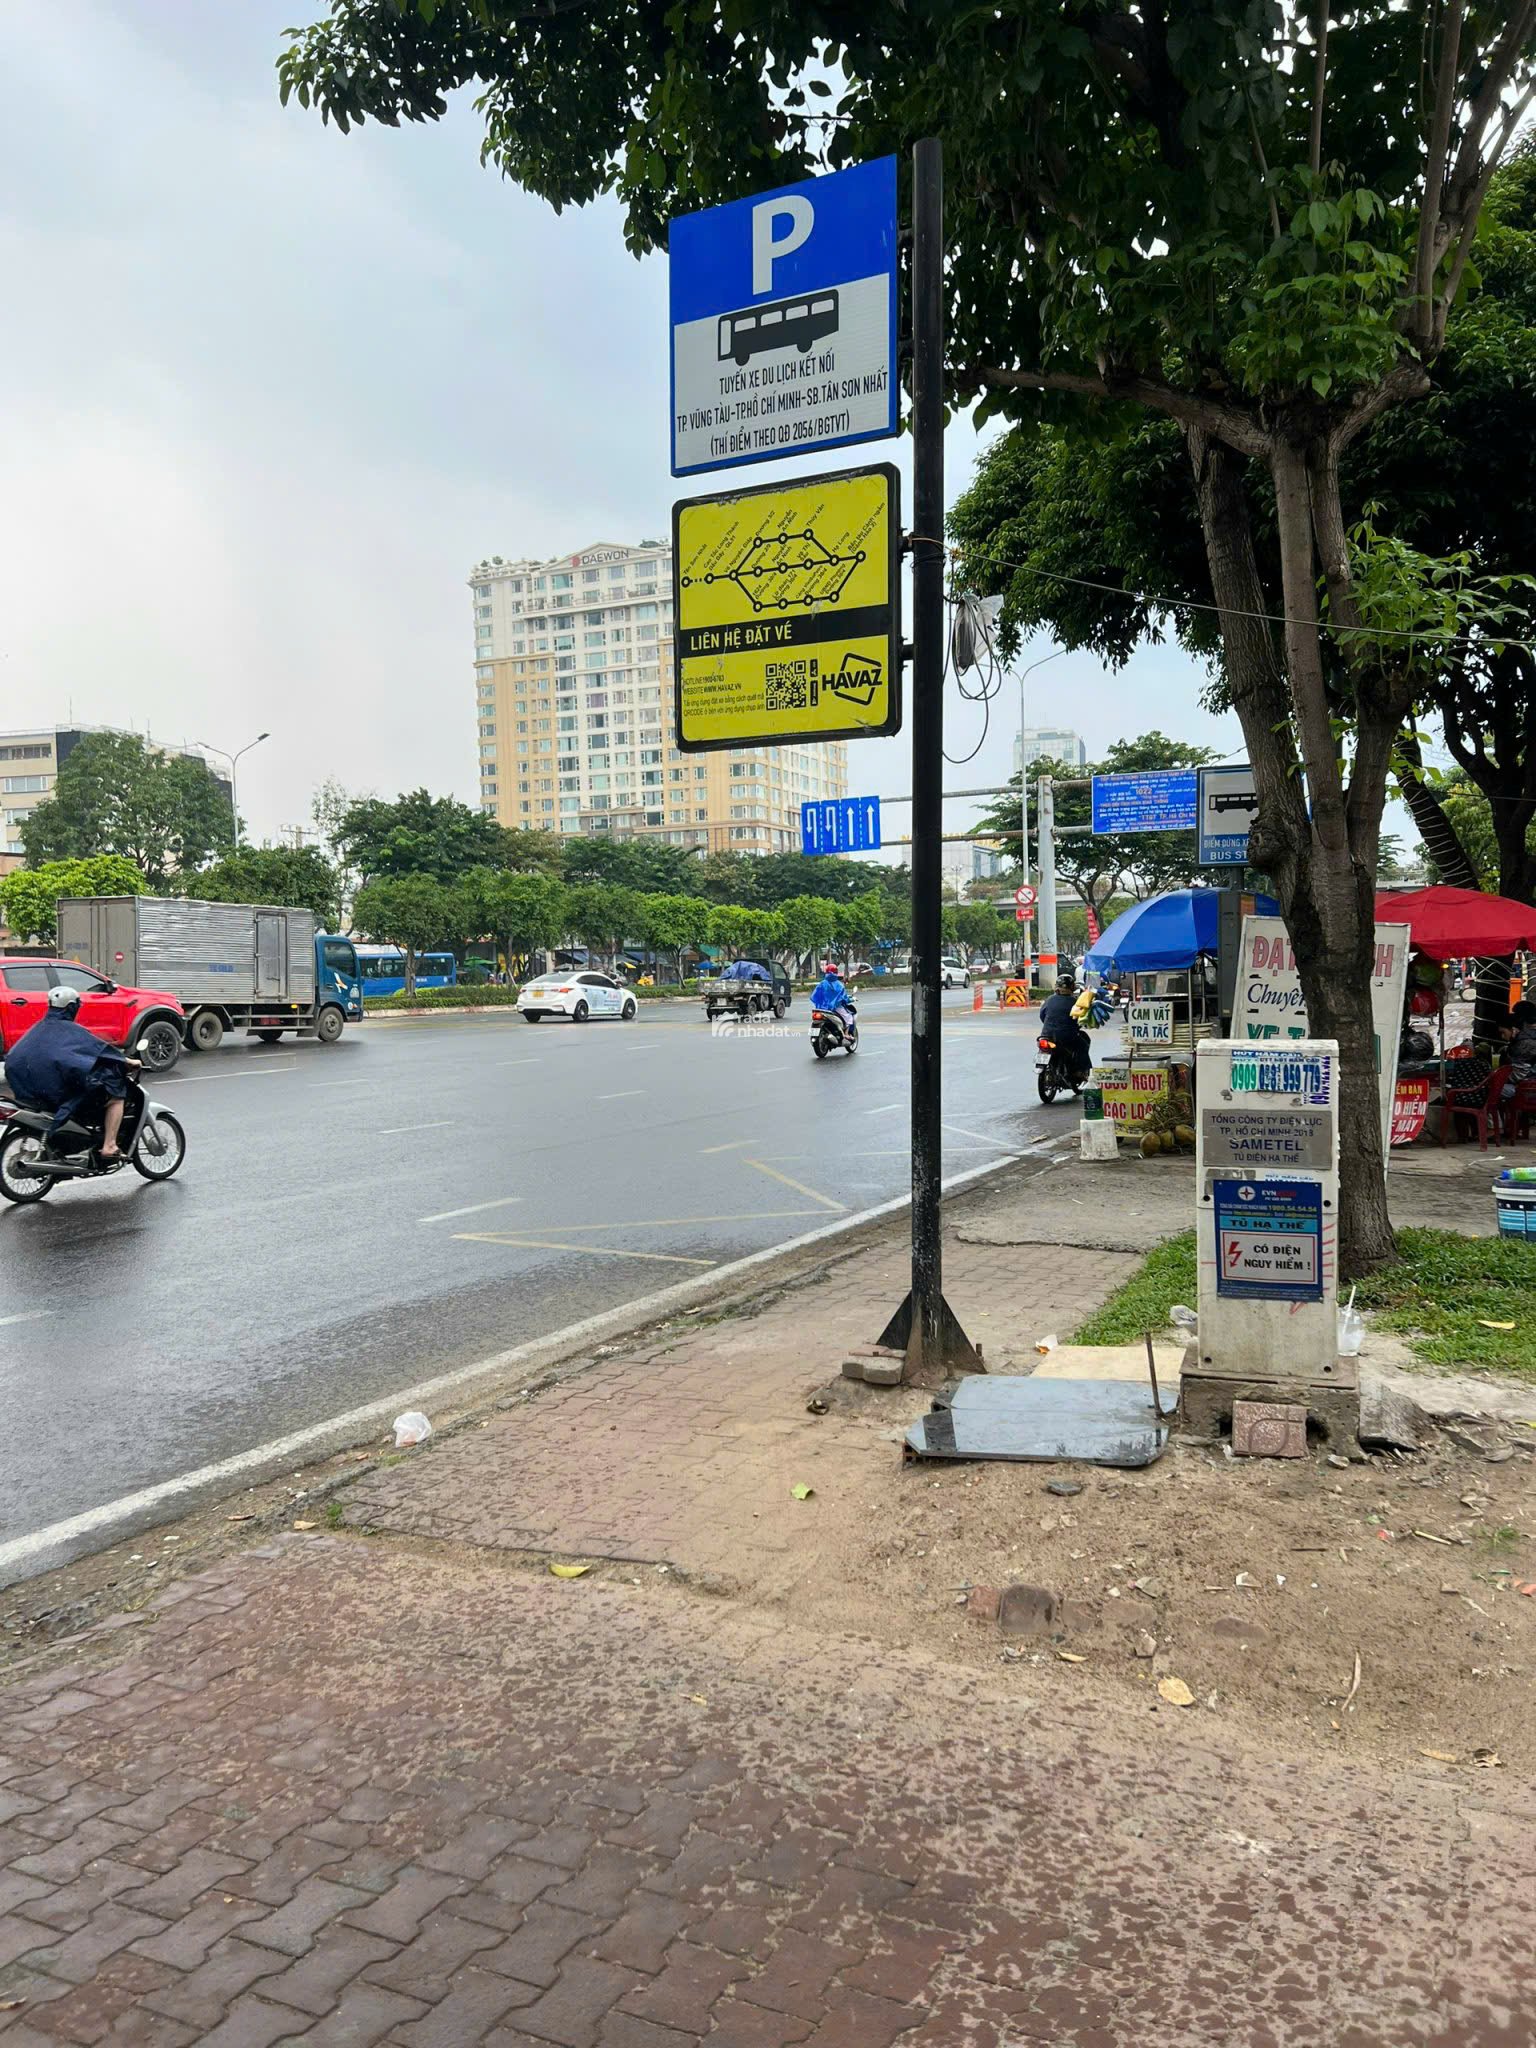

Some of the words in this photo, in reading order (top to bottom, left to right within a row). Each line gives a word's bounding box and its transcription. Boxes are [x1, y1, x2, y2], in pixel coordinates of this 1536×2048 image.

[752, 194, 815, 296] P
[719, 367, 746, 395] TUYẾN
[748, 369, 760, 389] XE
[762, 366, 774, 386] DU
[776, 361, 797, 385] LỊCH
[799, 351, 817, 378] KẾT
[819, 346, 835, 374] NỐI
[689, 408, 713, 431] VŨNG
[760, 390, 777, 416] CHÍ
[841, 377, 861, 399] SƠN
[863, 364, 888, 395] NHẤT
[710, 430, 728, 457] (THÍ
[729, 425, 751, 453] ĐIỂM
[753, 427, 776, 448] THEO
[778, 424, 791, 443] QĐ
[792, 408, 850, 441] 2056/BGTVT)
[582, 549, 629, 565] DAEWON
[690, 631, 720, 651] LIÊN
[724, 627, 742, 649] HỆ
[745, 624, 772, 647] ĐẶT
[774, 620, 792, 641] VÉ
[822, 669, 882, 691] HAVAZ
[1210, 851, 1232, 861] BUS
[1234, 850, 1248, 860] ST
[1131, 1008, 1150, 1020] CAM
[1131, 1020, 1149, 1038] TRÀ
[1238, 1114, 1264, 1125] CÔNG
[1266, 1116, 1277, 1124] TY
[1229, 1138, 1304, 1151] SAMETEL
[1230, 1217, 1248, 1227] TỦ
[1253, 1219, 1272, 1230] HẠ
[1277, 1219, 1305, 1230] THẾ
[1253, 1243, 1269, 1254] CÓ
[1272, 1244, 1301, 1257] ĐIỆN
[1243, 1258, 1272, 1269] NGUY
[1275, 1256, 1304, 1270] HIỂM
